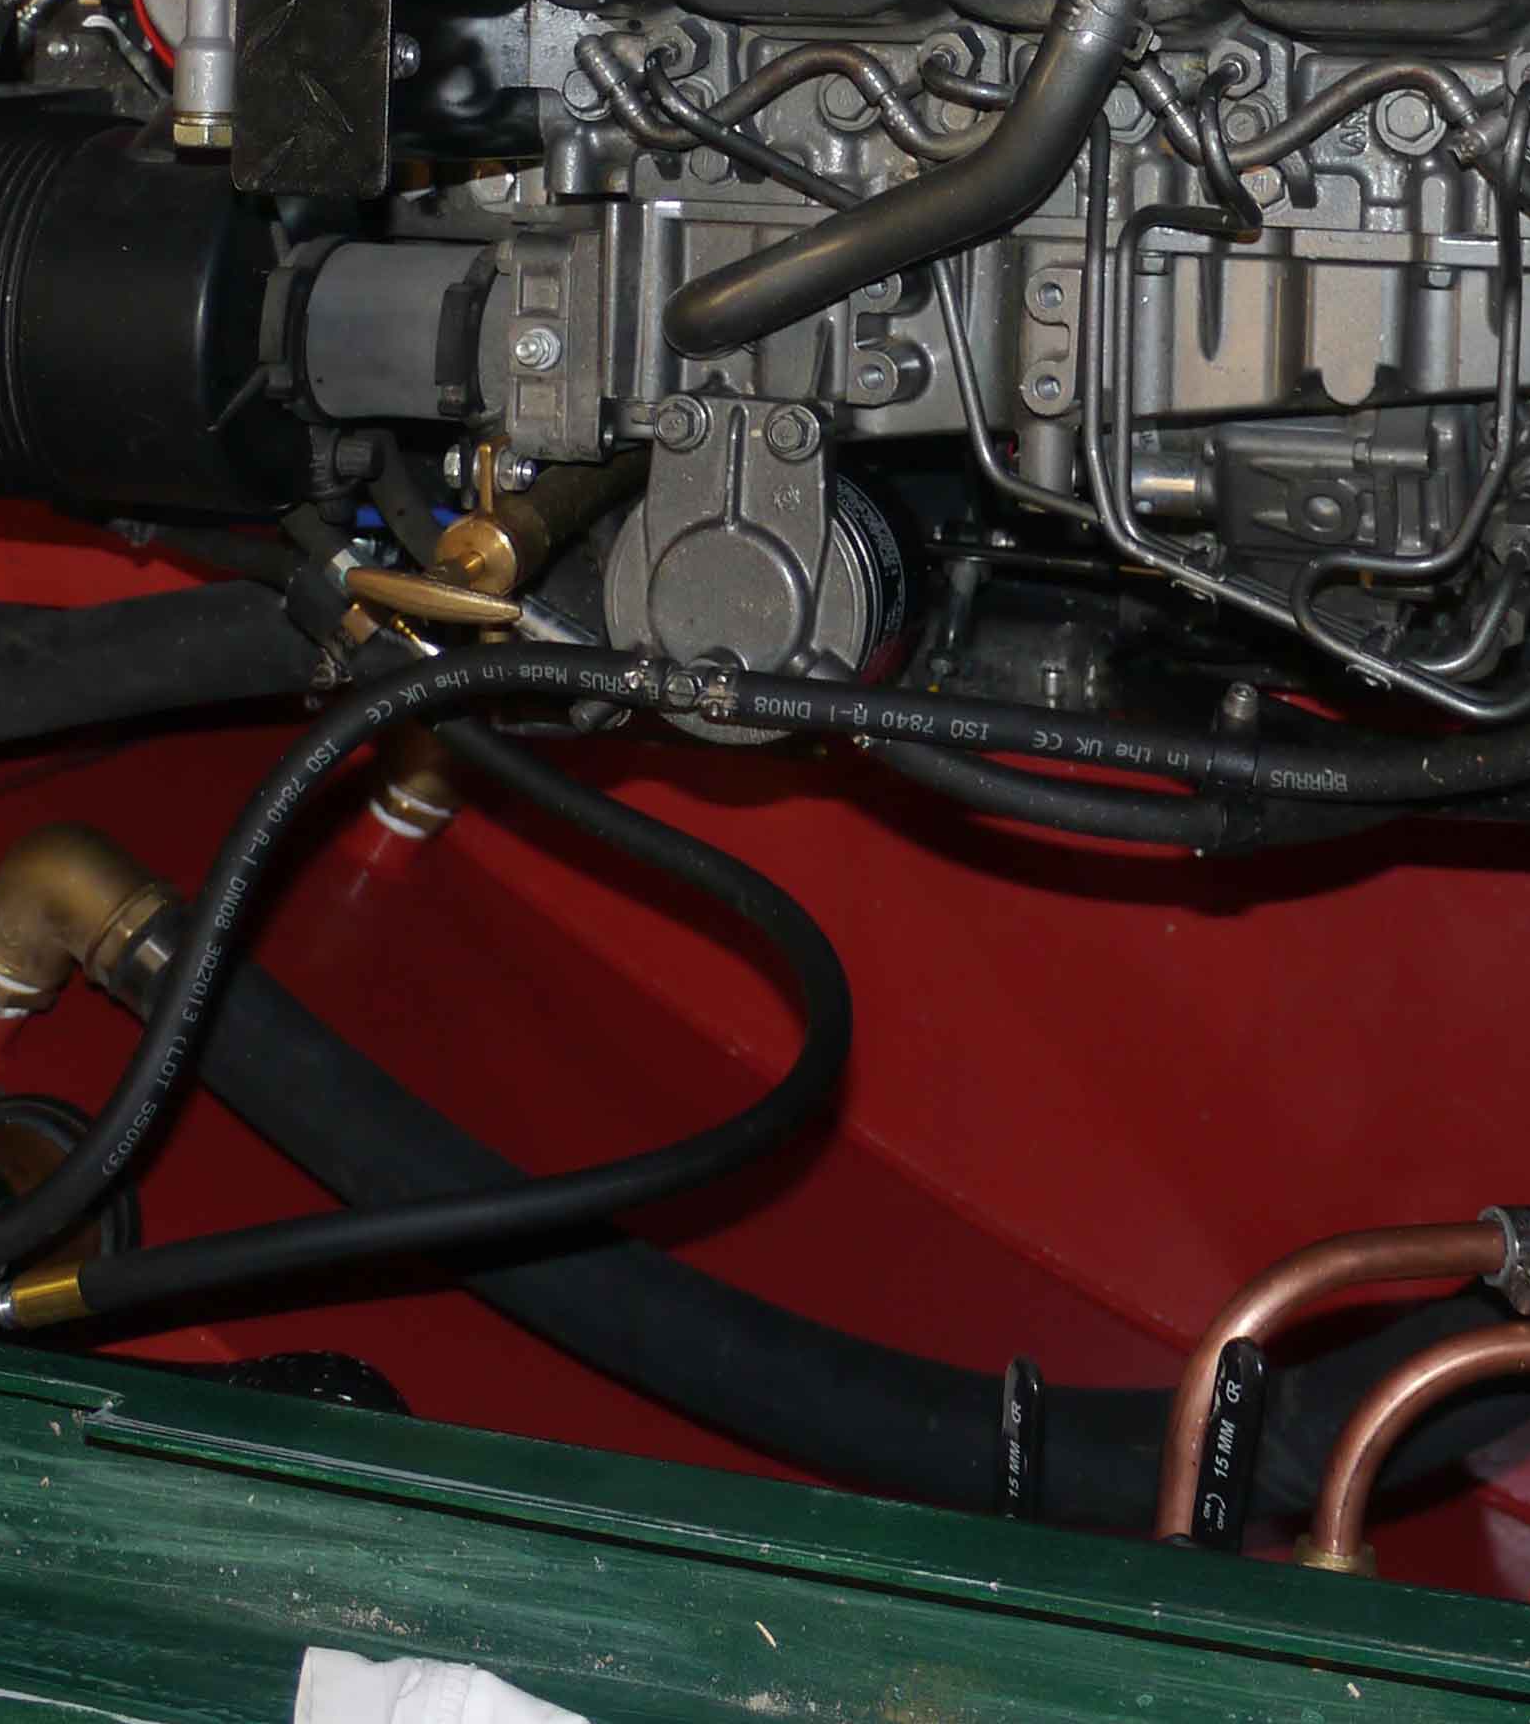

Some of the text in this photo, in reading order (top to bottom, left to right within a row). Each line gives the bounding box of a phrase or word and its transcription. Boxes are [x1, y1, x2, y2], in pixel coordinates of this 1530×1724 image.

[435, 669, 471, 690] the
[519, 663, 568, 685] Made
[399, 682, 430, 707] UK
[753, 694, 813, 719] DN08
[880, 710, 935, 735] 7840
[949, 718, 990, 741] ISO
[306, 739, 341, 774] ISO
[1075, 736, 1103, 757] UK
[1115, 741, 1151, 763] the
[266, 775, 308, 825] 7840
[214, 876, 249, 931] DN08
[1217, 1418, 1237, 1457] MM
[1008, 1438, 1021, 1475] MM
[1213, 1454, 1231, 1479] 15
[1008, 1475, 1020, 1499] 15
